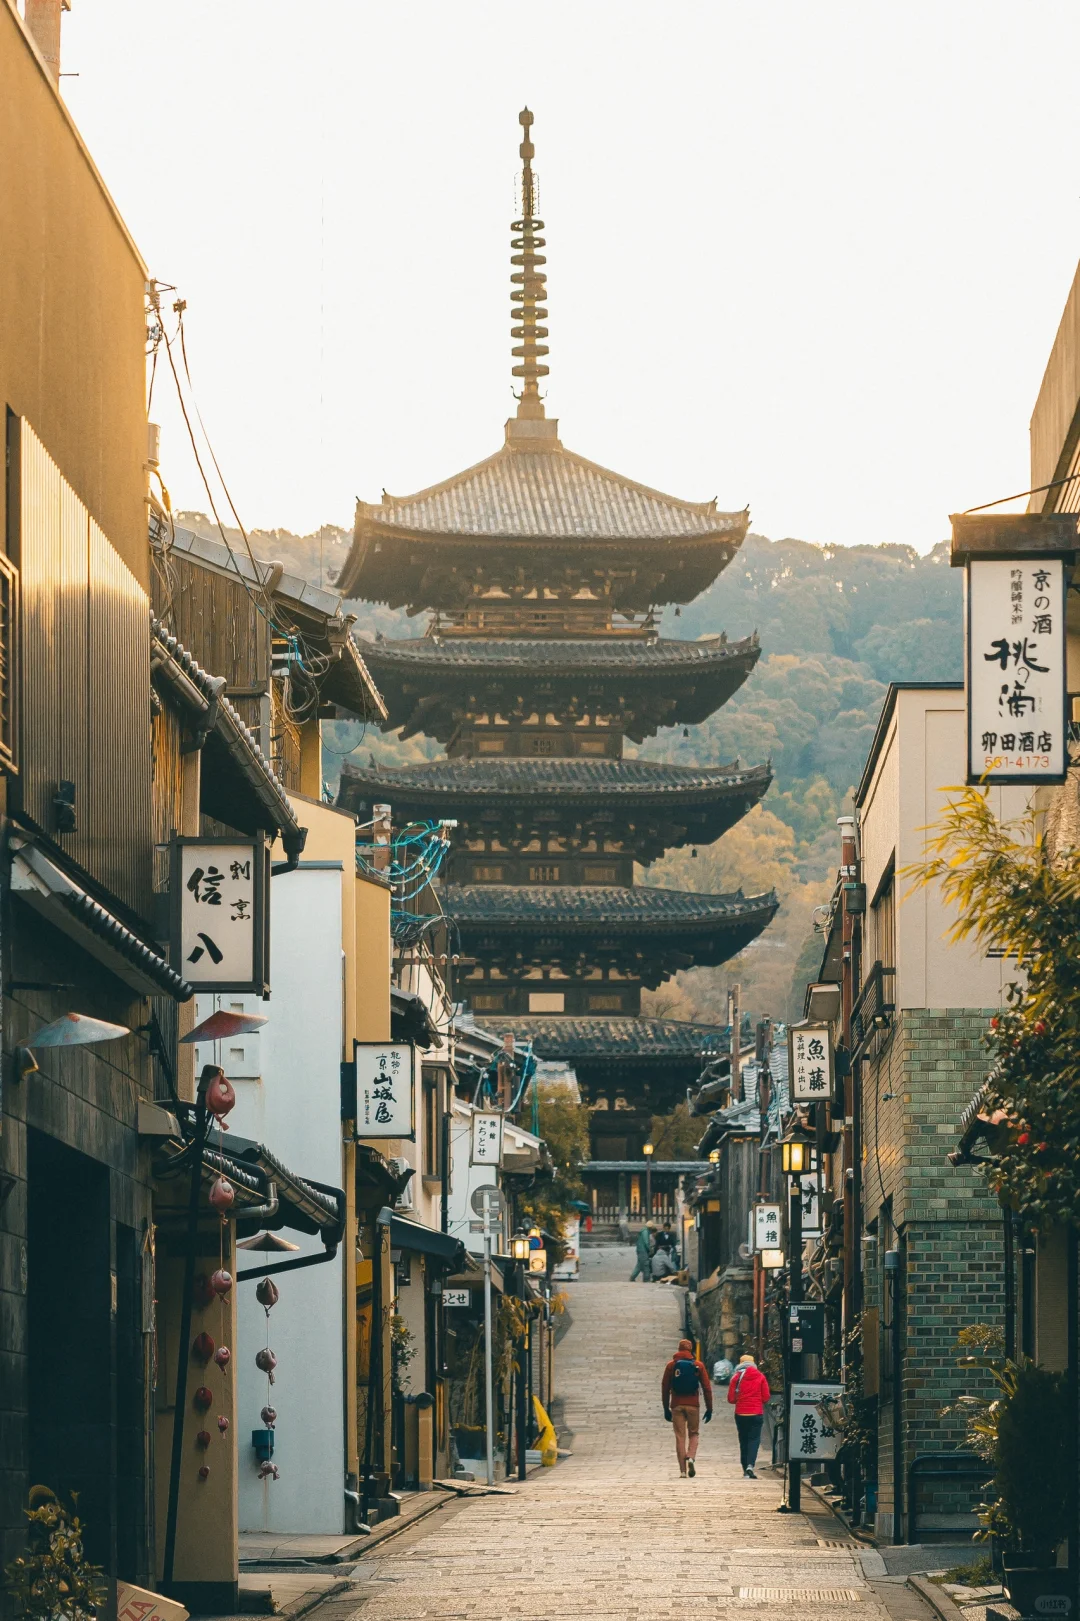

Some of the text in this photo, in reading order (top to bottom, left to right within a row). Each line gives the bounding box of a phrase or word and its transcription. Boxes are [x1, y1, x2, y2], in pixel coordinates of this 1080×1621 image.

[1032, 569, 1052, 635] 京の酒
[981, 731, 1053, 754] 卯田酒店
[187, 866, 225, 964] 信八
[230, 861, 251, 921] 割烹
[807, 1038, 827, 1091] 魚藤
[477, 1127, 487, 1156] ちとせ
[800, 1413, 818, 1454] 魚藤
